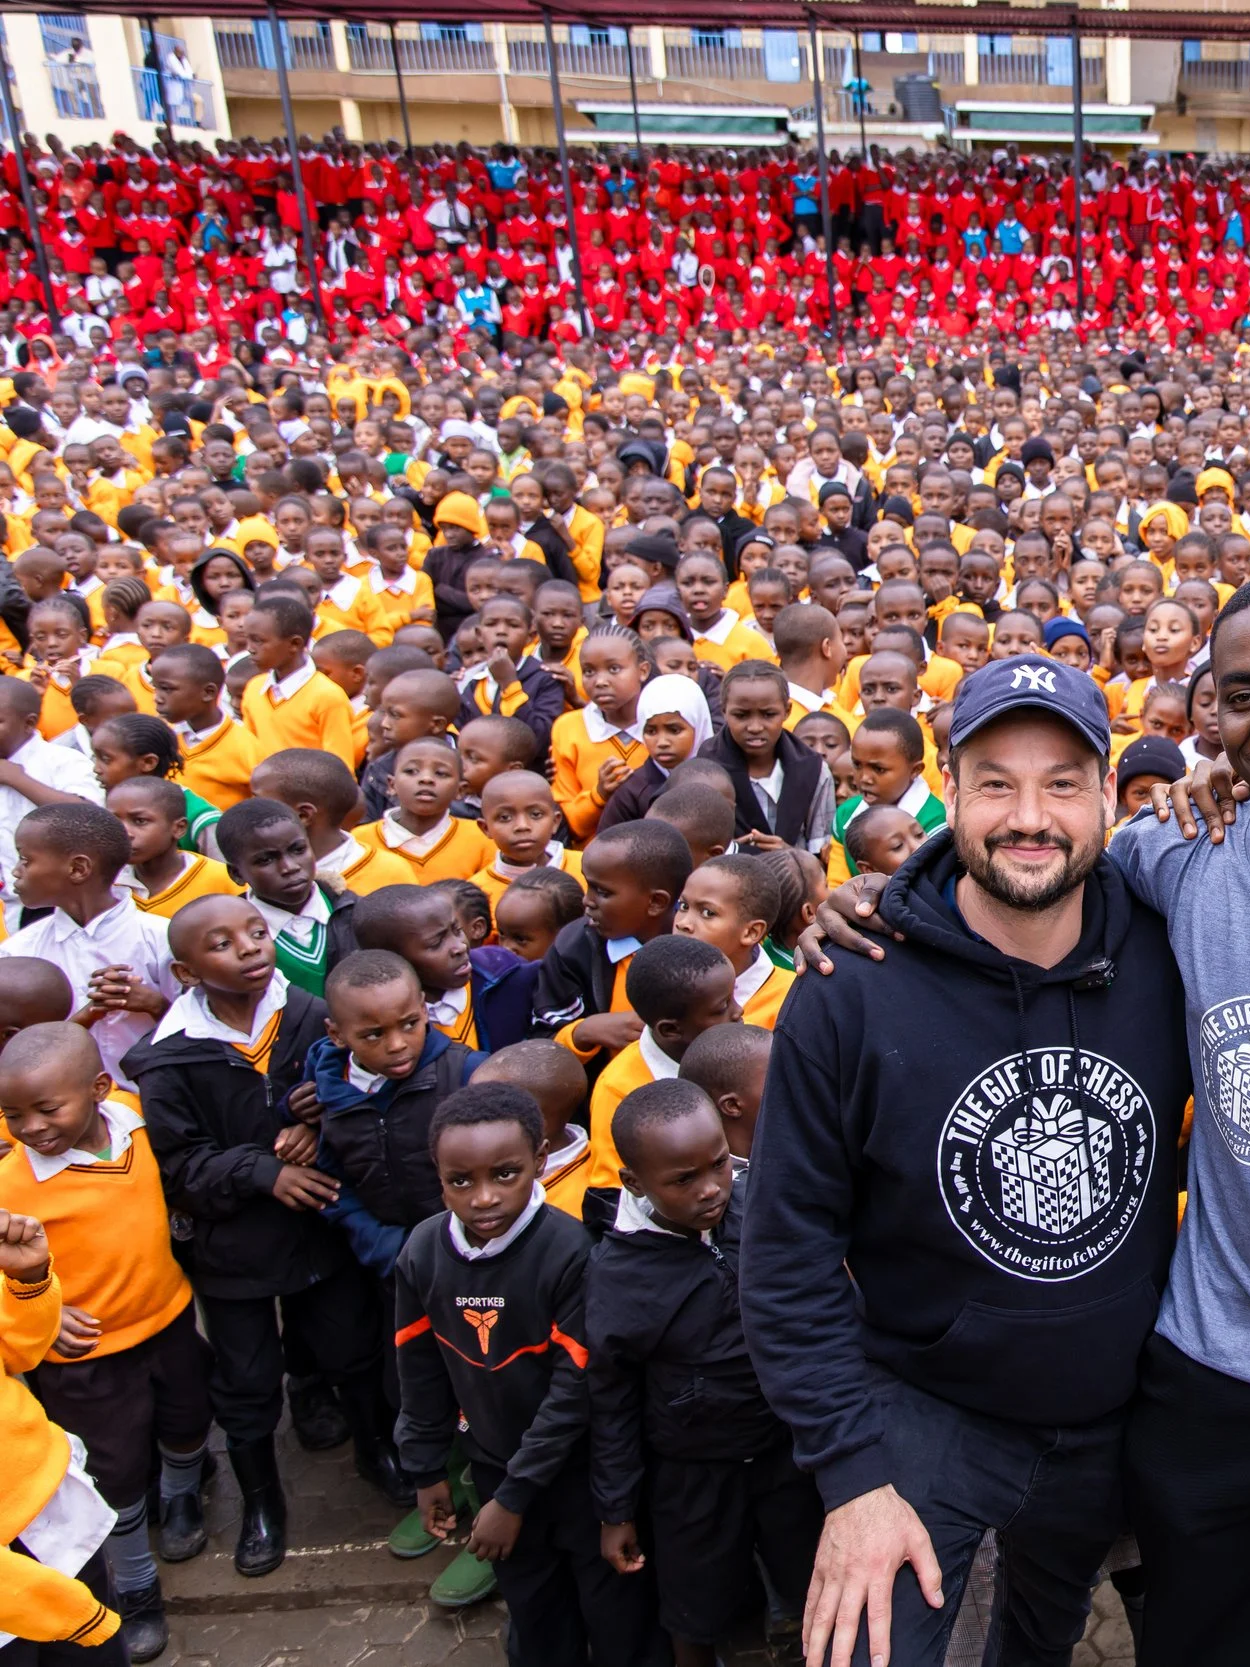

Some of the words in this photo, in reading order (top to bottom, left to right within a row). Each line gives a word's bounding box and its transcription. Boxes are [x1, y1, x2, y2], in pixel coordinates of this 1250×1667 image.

[947, 1093, 994, 1145] THE
[1041, 1053, 1072, 1085] OF
[970, 1195, 1139, 1273] www.thegiftofchess.org
[455, 1296, 505, 1308] SPORTKEB
